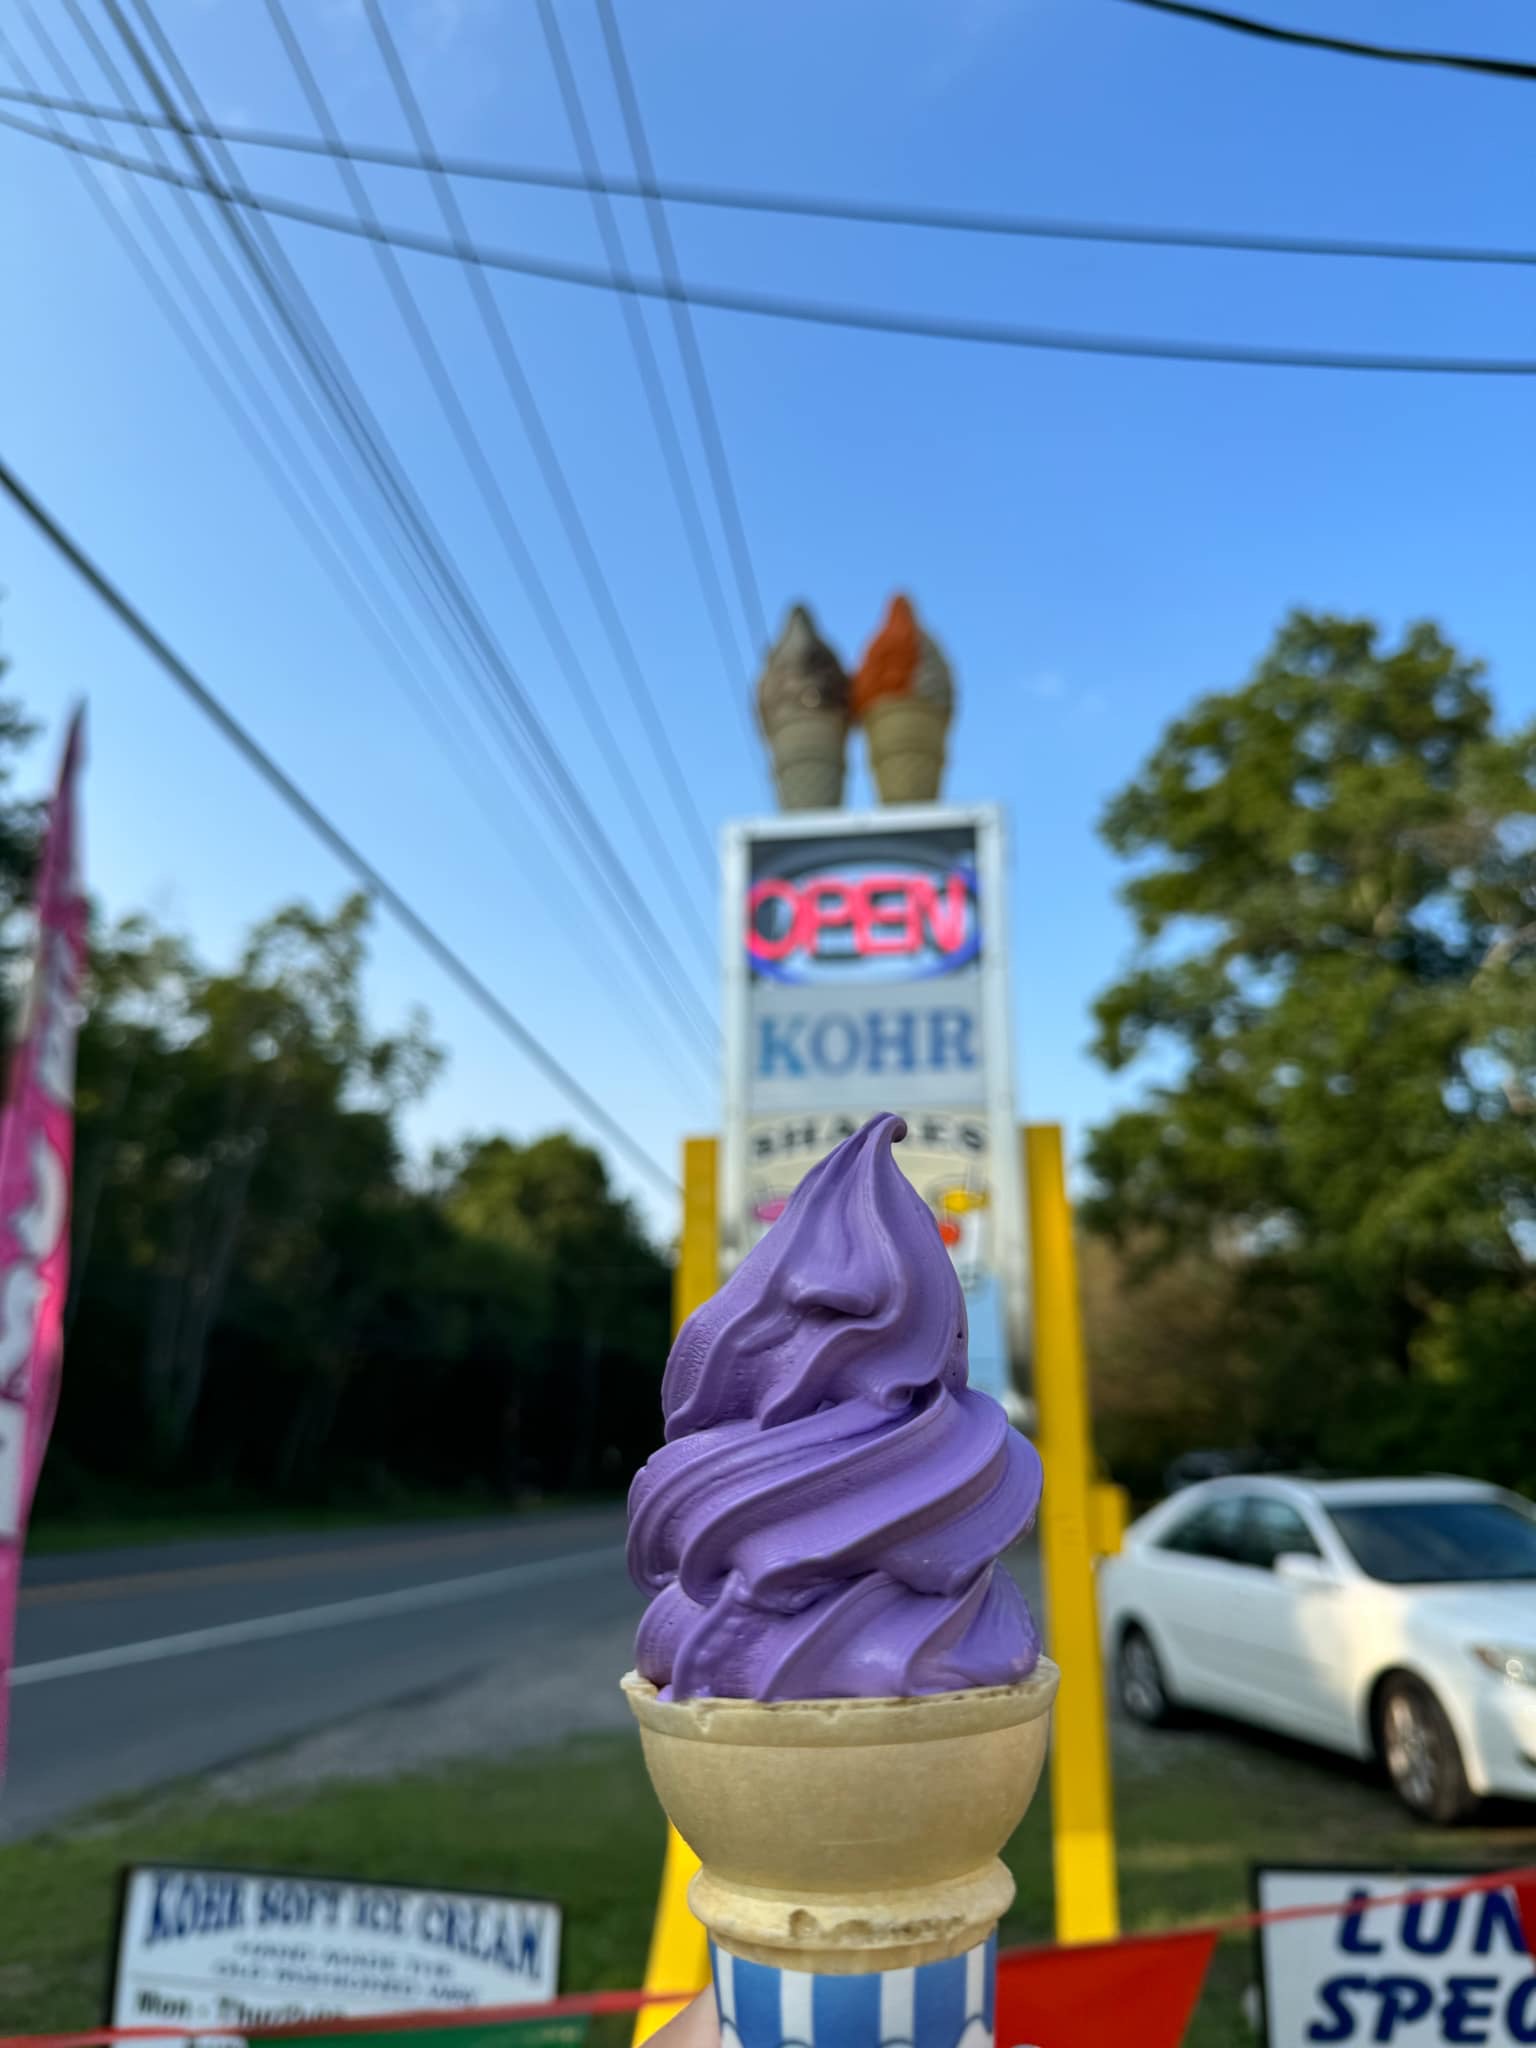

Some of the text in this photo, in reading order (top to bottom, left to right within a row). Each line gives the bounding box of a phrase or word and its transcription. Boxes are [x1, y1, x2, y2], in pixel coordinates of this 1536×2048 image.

[746, 872, 968, 961] OPEN
[757, 1009, 976, 1078] KOHR
[753, 1113, 984, 1154] SHAES
[144, 1873, 244, 1945] KOHR
[258, 1881, 343, 1926] SOFT
[422, 1894, 542, 1980] CREAM
